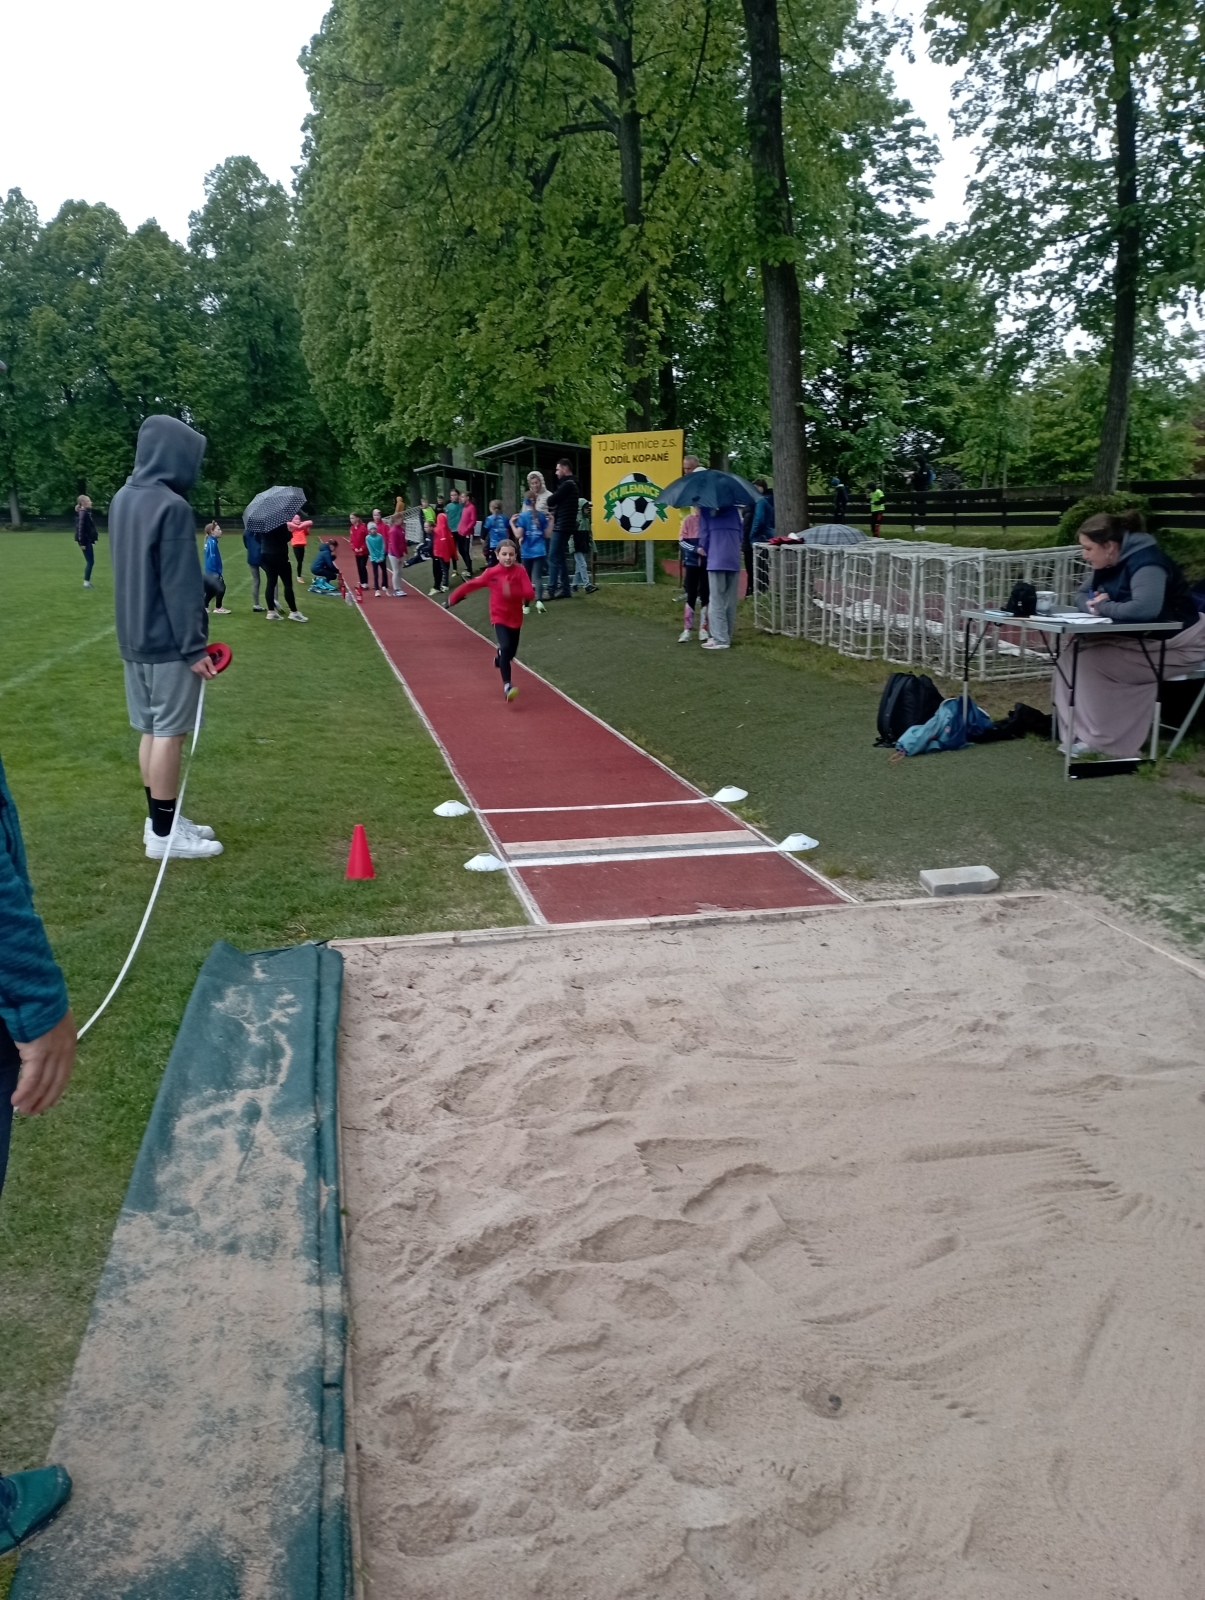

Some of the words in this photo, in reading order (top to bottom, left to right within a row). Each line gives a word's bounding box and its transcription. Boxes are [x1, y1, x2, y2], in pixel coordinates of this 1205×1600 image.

[597, 441, 607, 451] TJ
[610, 438, 659, 451] Jilemnice
[604, 453, 631, 464] ODDÍL
[632, 451, 669, 463] KOPANÉ
[609, 488, 618, 500] SK
[620, 484, 660, 498] JILEMNICE
